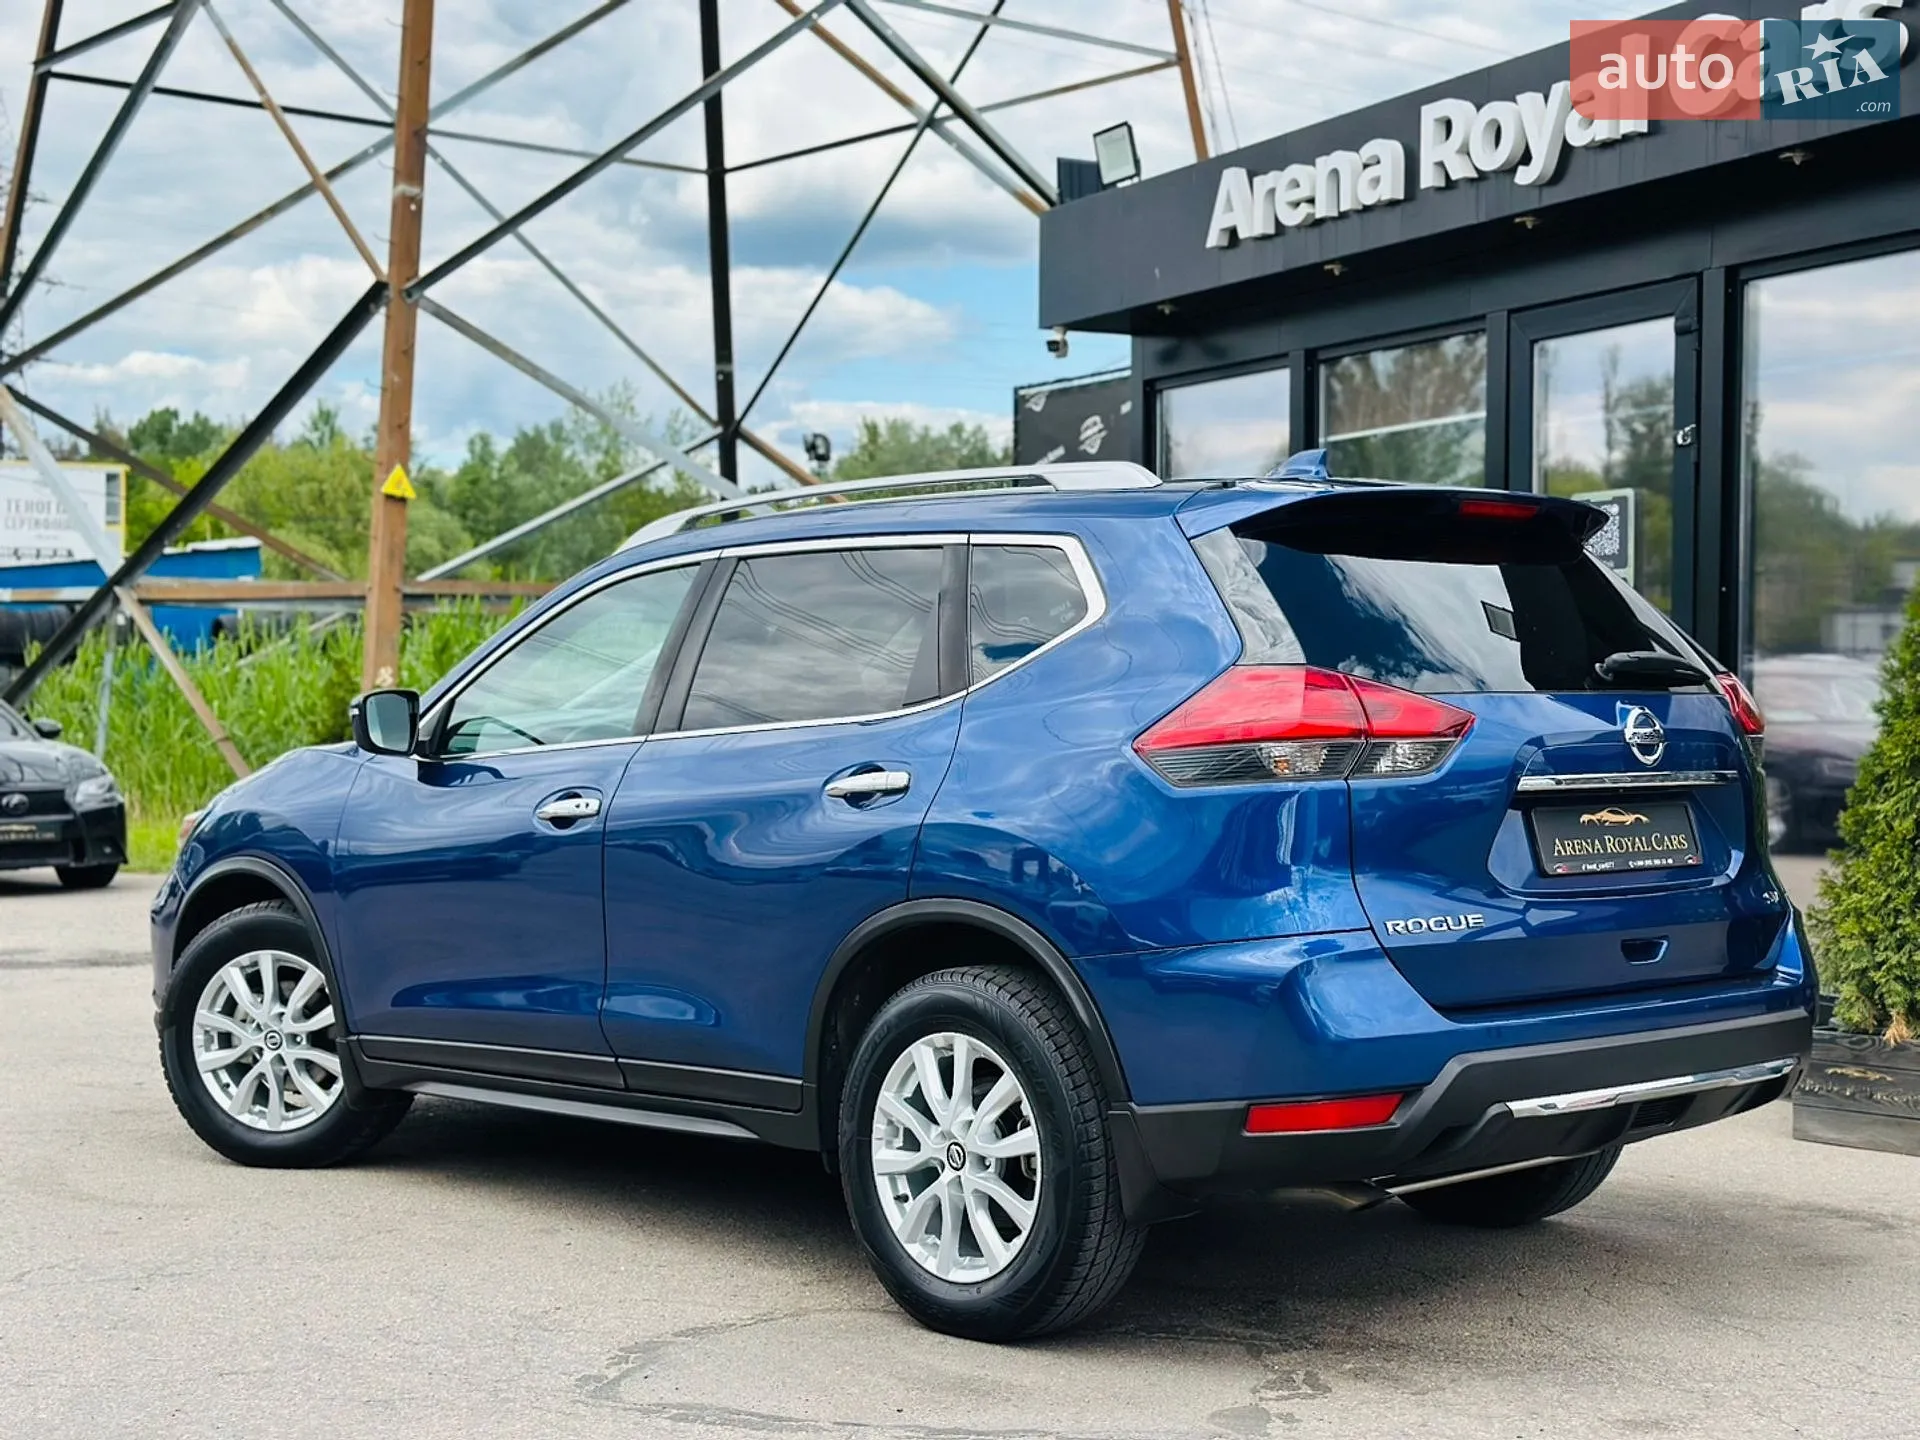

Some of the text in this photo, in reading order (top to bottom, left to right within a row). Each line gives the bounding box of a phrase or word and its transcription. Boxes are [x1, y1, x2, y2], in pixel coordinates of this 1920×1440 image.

[1205, 138, 1405, 249] Arena
[1419, 33, 1650, 189] Royal
[1553, 832, 1688, 857] ARENA ROYAL CARS
[1384, 913, 1485, 936] ROGUE
